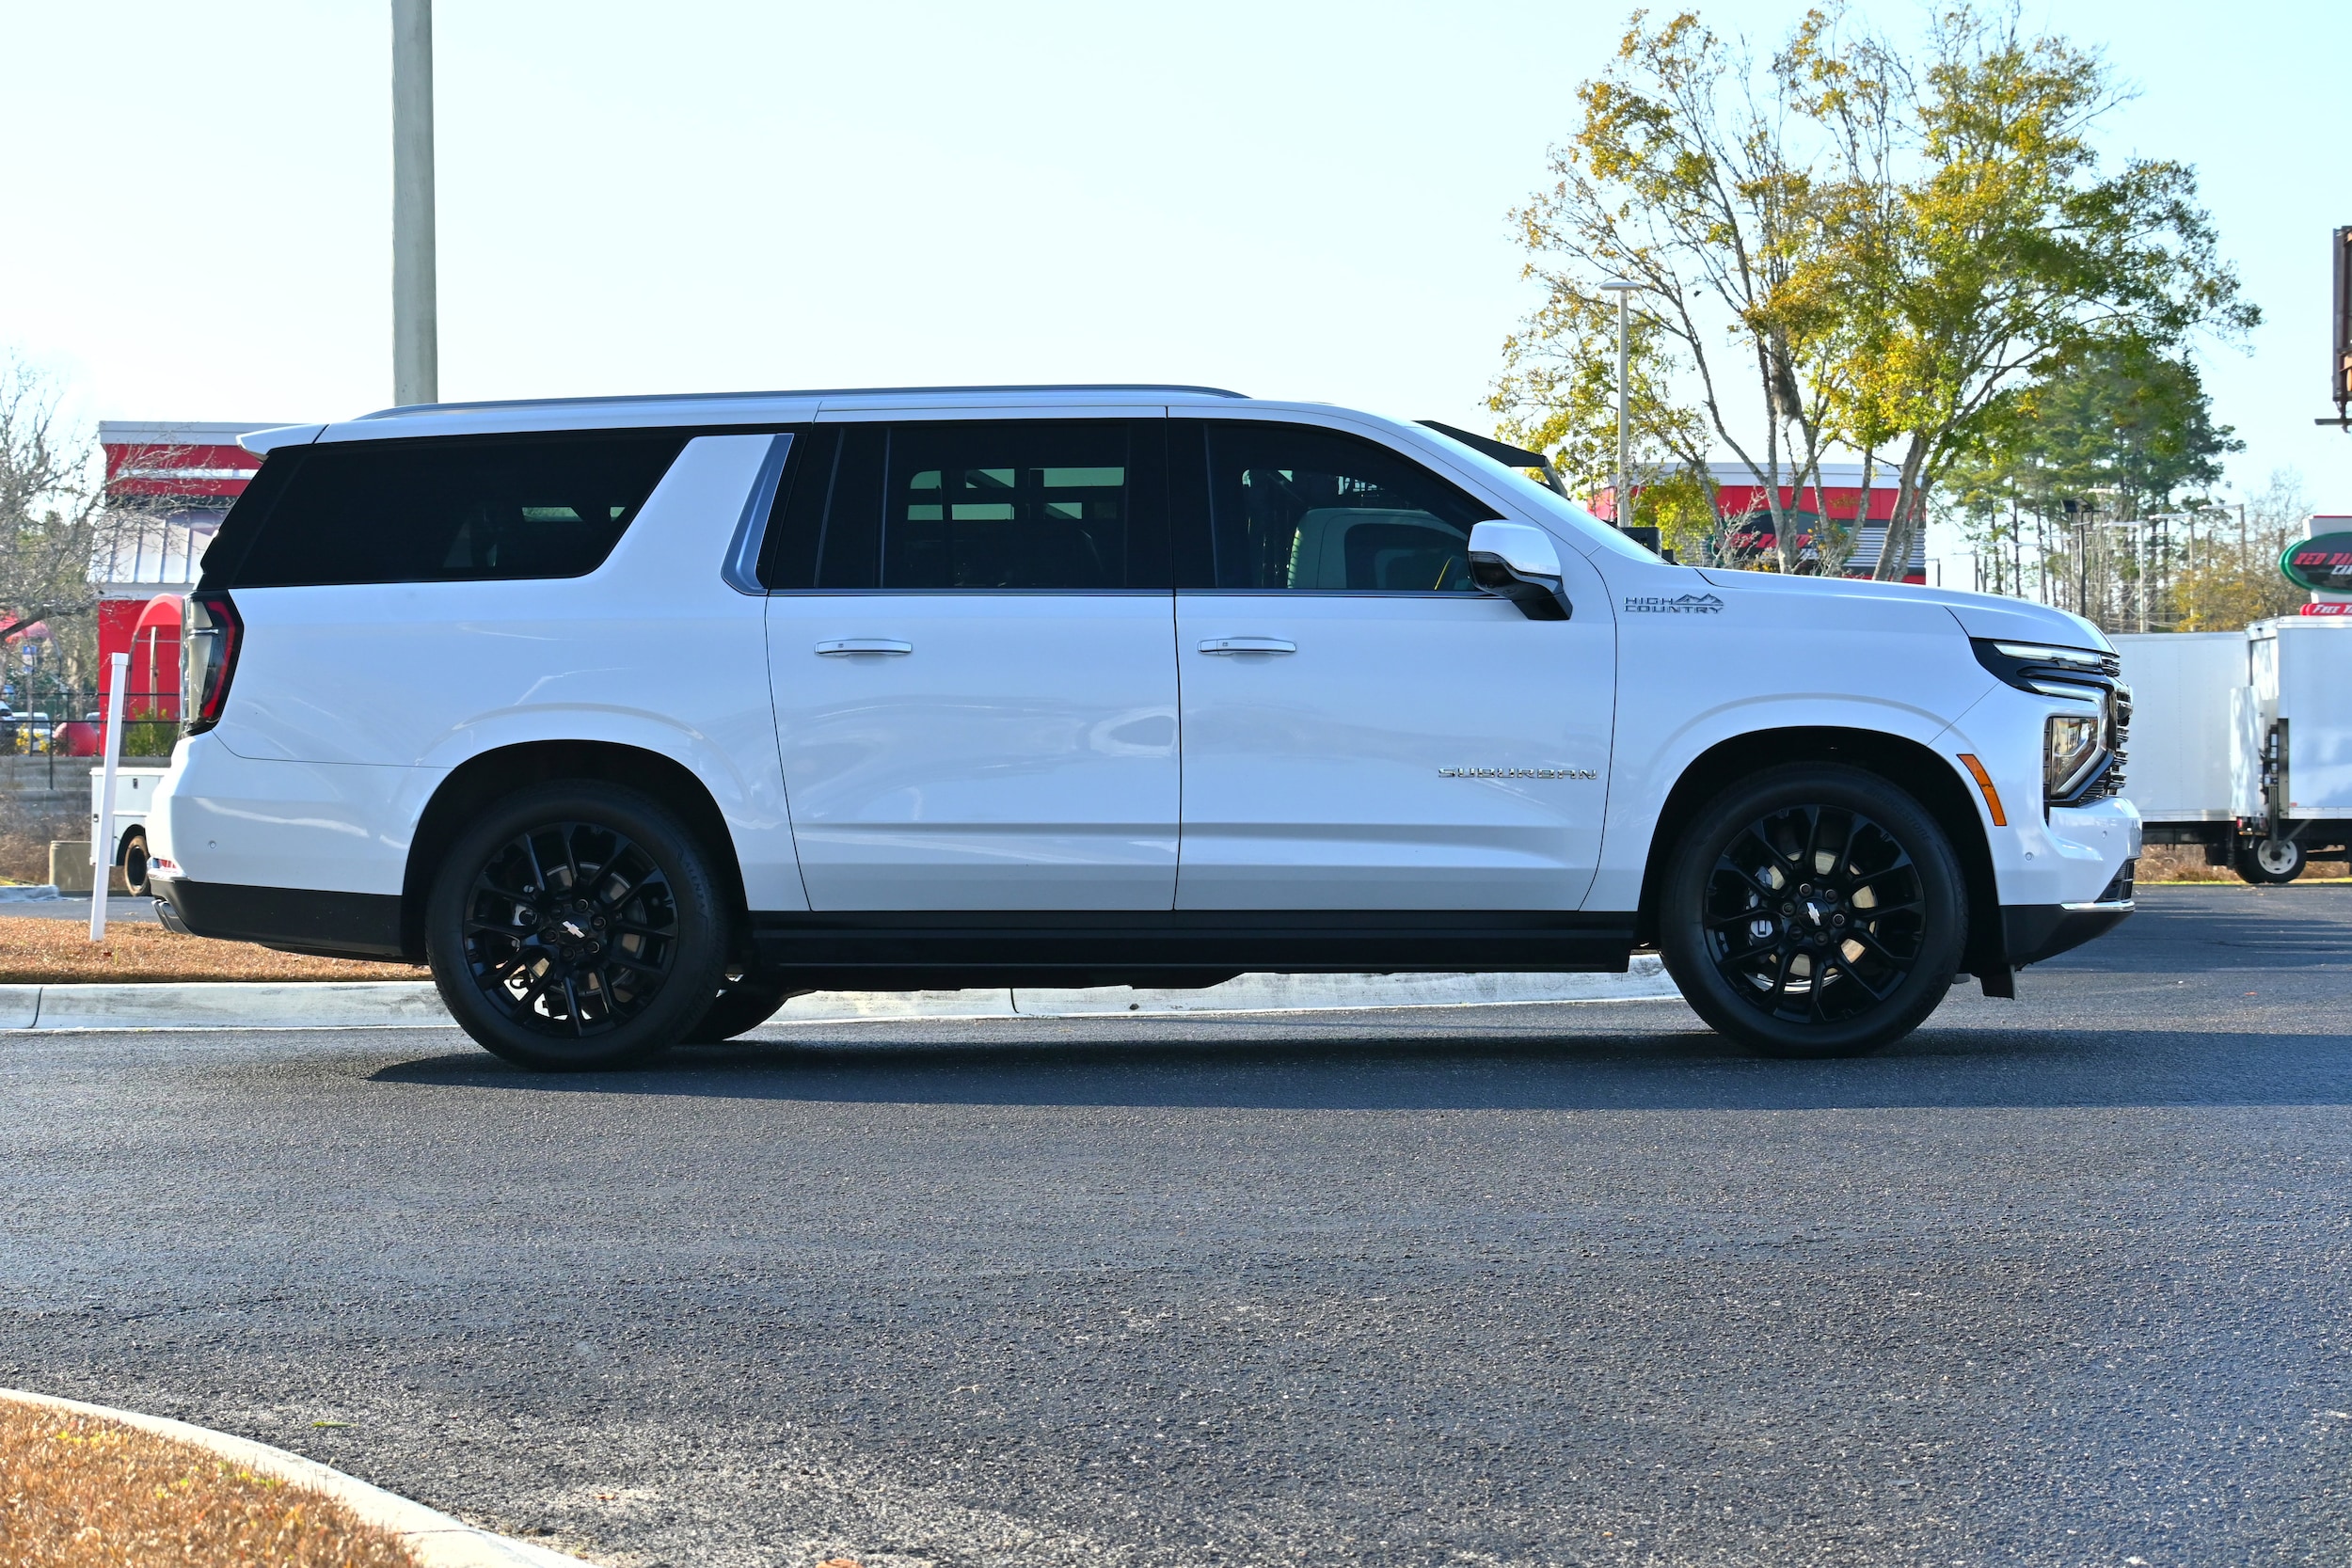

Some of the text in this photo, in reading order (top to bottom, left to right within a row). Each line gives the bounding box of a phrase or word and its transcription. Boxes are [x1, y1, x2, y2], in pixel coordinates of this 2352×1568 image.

[2294, 552, 2328, 565] RED
[1625, 596, 1674, 605] HIGH
[1625, 605, 1724, 613] COUNTRY
[1438, 768, 1597, 780] SUBURBAN
